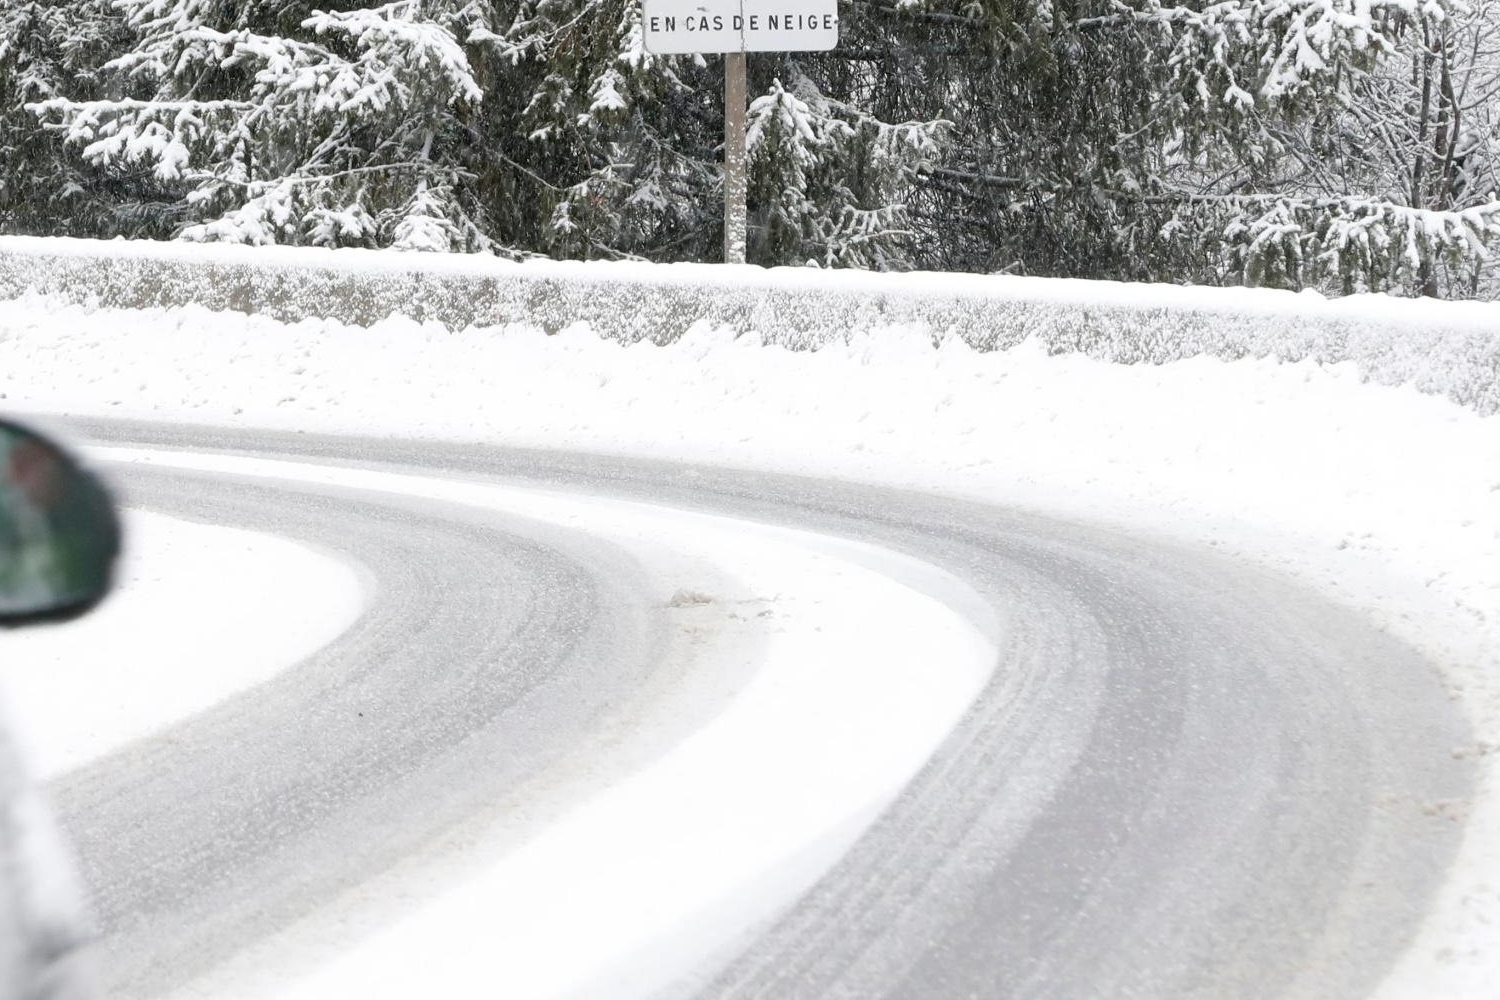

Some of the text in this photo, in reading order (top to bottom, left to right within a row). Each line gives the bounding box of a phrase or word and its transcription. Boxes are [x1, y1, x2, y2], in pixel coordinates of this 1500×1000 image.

[650, 14, 832, 32] EN CAS DE NEIGE
